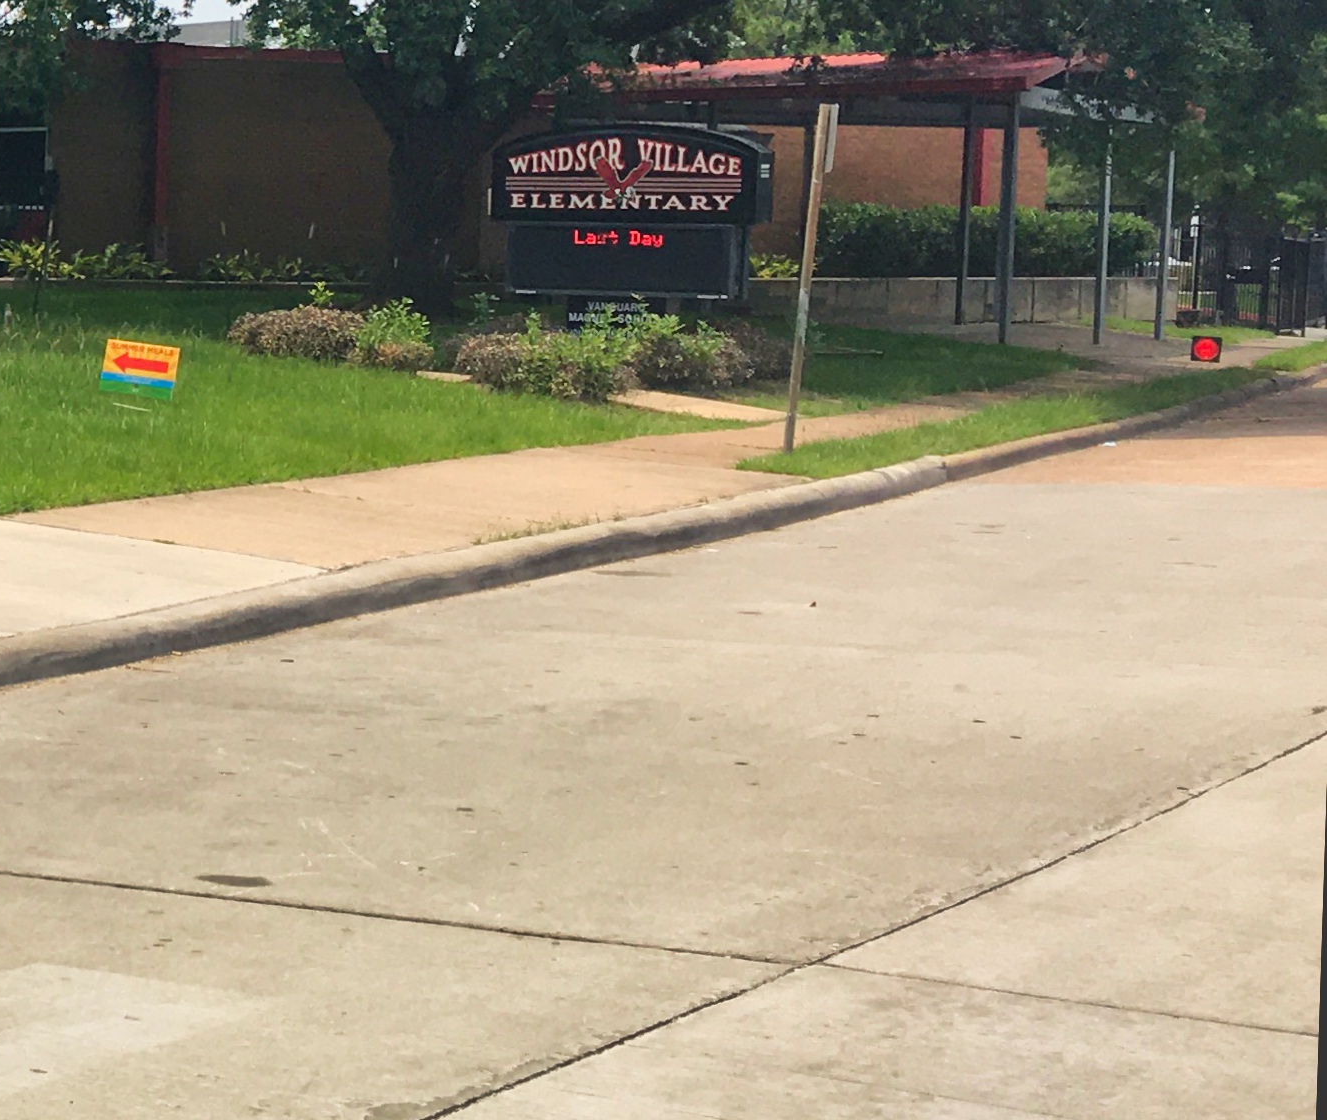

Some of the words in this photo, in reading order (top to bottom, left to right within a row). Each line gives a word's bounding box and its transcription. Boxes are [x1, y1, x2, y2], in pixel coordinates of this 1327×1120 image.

[508, 137, 624, 174] WINDSOR
[637, 138, 742, 176] VILLAGE
[510, 192, 734, 211] ELEMENTARY
[629, 230, 664, 248] Day
